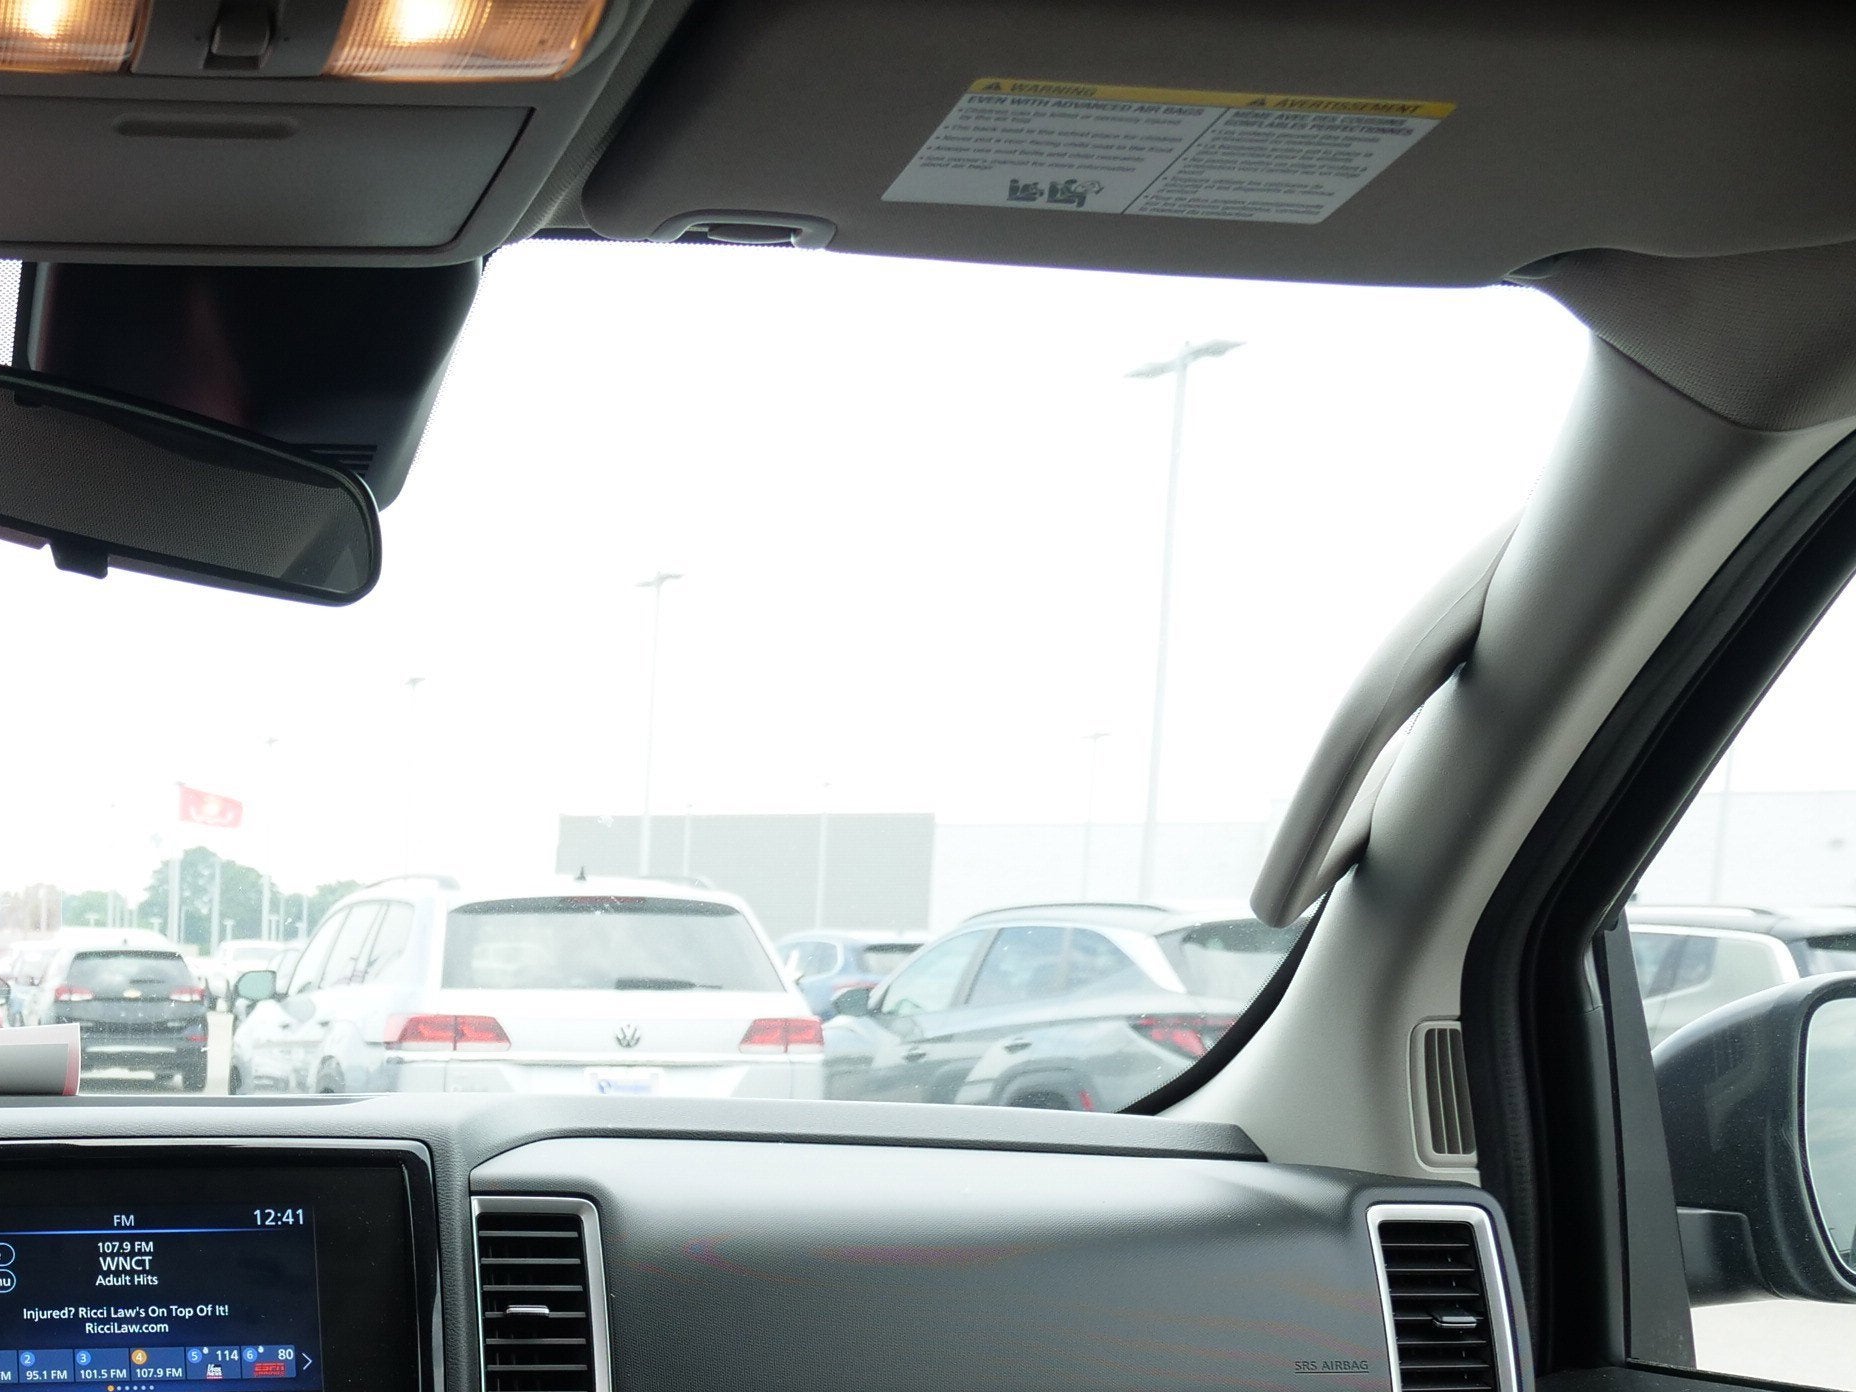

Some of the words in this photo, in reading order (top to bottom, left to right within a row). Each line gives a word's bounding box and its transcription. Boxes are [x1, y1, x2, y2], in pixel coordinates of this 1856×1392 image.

[1053, 100, 1132, 111] ADVANCED
[113, 1215, 135, 1227] FM
[253, 1209, 305, 1226] 12:41
[97, 1241, 132, 1253] 107.9
[134, 1241, 154, 1252] FM
[99, 1256, 152, 1271] WNCT
[95, 1274, 130, 1286] Adult
[134, 1274, 159, 1286] Hits
[23, 1307, 75, 1321] Injured?
[78, 1306, 107, 1319] Ricci
[110, 1306, 145, 1318] Law's
[148, 1306, 167, 1317] On
[170, 1305, 195, 1319] Top
[196, 1304, 215, 1316] Of
[216, 1304, 229, 1316] It!
[85, 1321, 169, 1334] RicciLaw.com
[215, 1349, 239, 1362] 114
[278, 1348, 294, 1360] 80
[1294, 1360, 1319, 1370] SRS
[1321, 1360, 1369, 1370] AIRBAG
[26, 1369, 49, 1381] 95.1
[50, 1369, 68, 1380] FM
[80, 1368, 107, 1379] 101.5
[109, 1368, 127, 1379] FM
[135, 1367, 162, 1379] 107.9
[164, 1367, 183, 1378] FM
